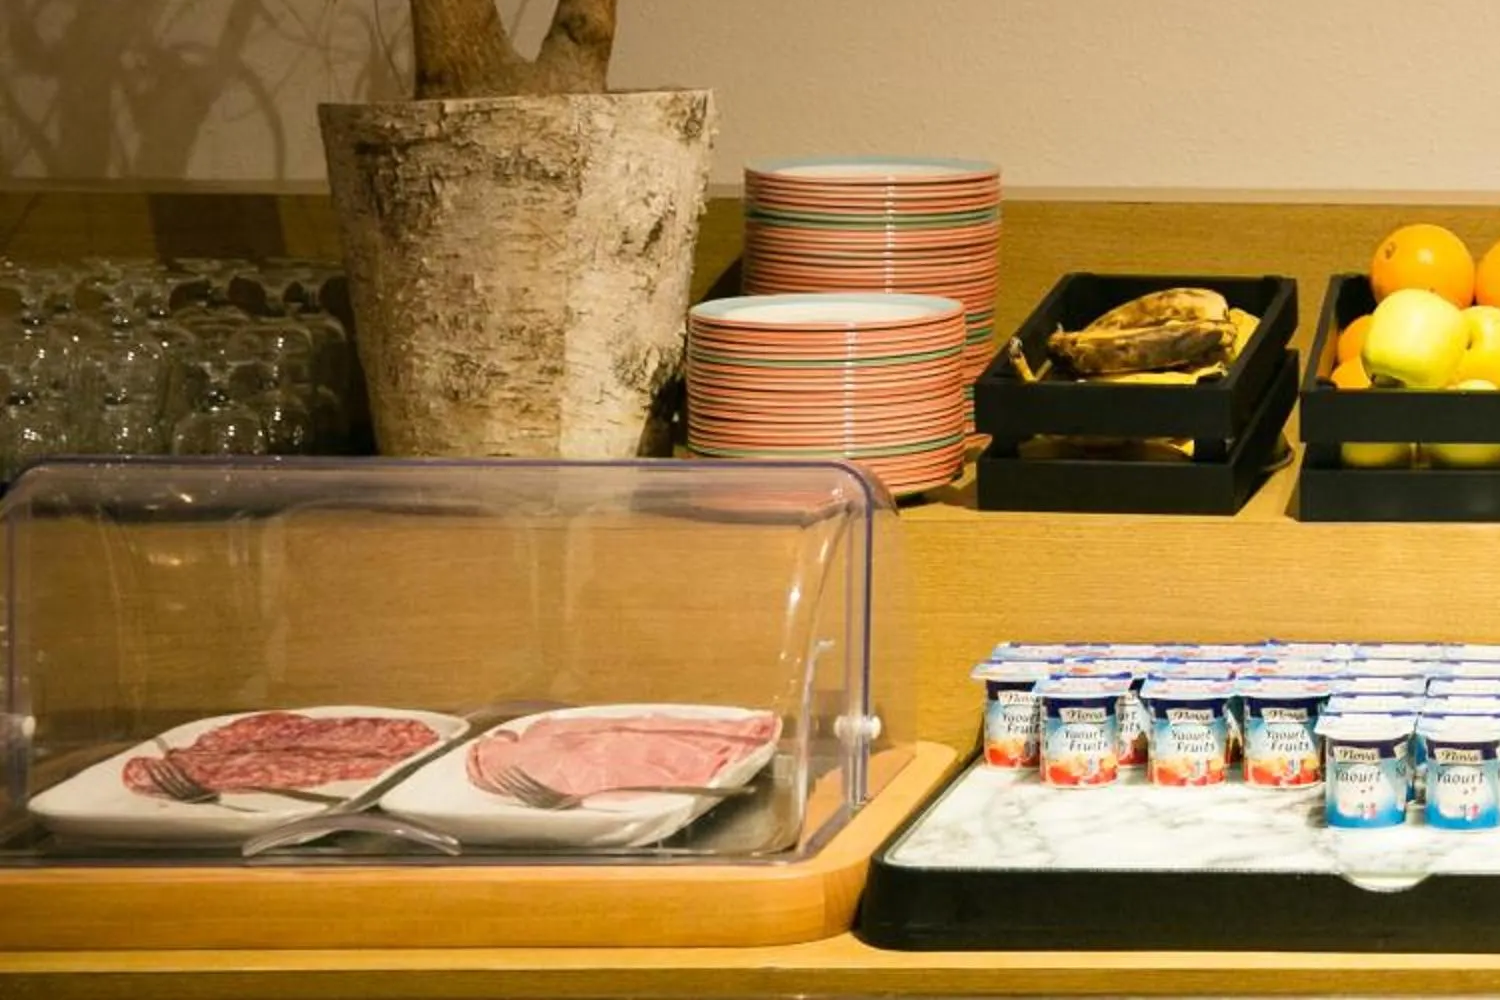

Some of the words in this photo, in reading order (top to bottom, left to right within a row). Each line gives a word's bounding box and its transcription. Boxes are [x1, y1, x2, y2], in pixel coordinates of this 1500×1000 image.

[1065, 729, 1105, 741] Yaourt
[1172, 729, 1212, 741] Yaourt
[1267, 729, 1307, 741] Yaourt
[1176, 741, 1215, 753] Fruits
[1270, 740, 1310, 752] Fruits
[1335, 767, 1382, 784] Yaourt
[1436, 769, 1485, 785] Yaourt
